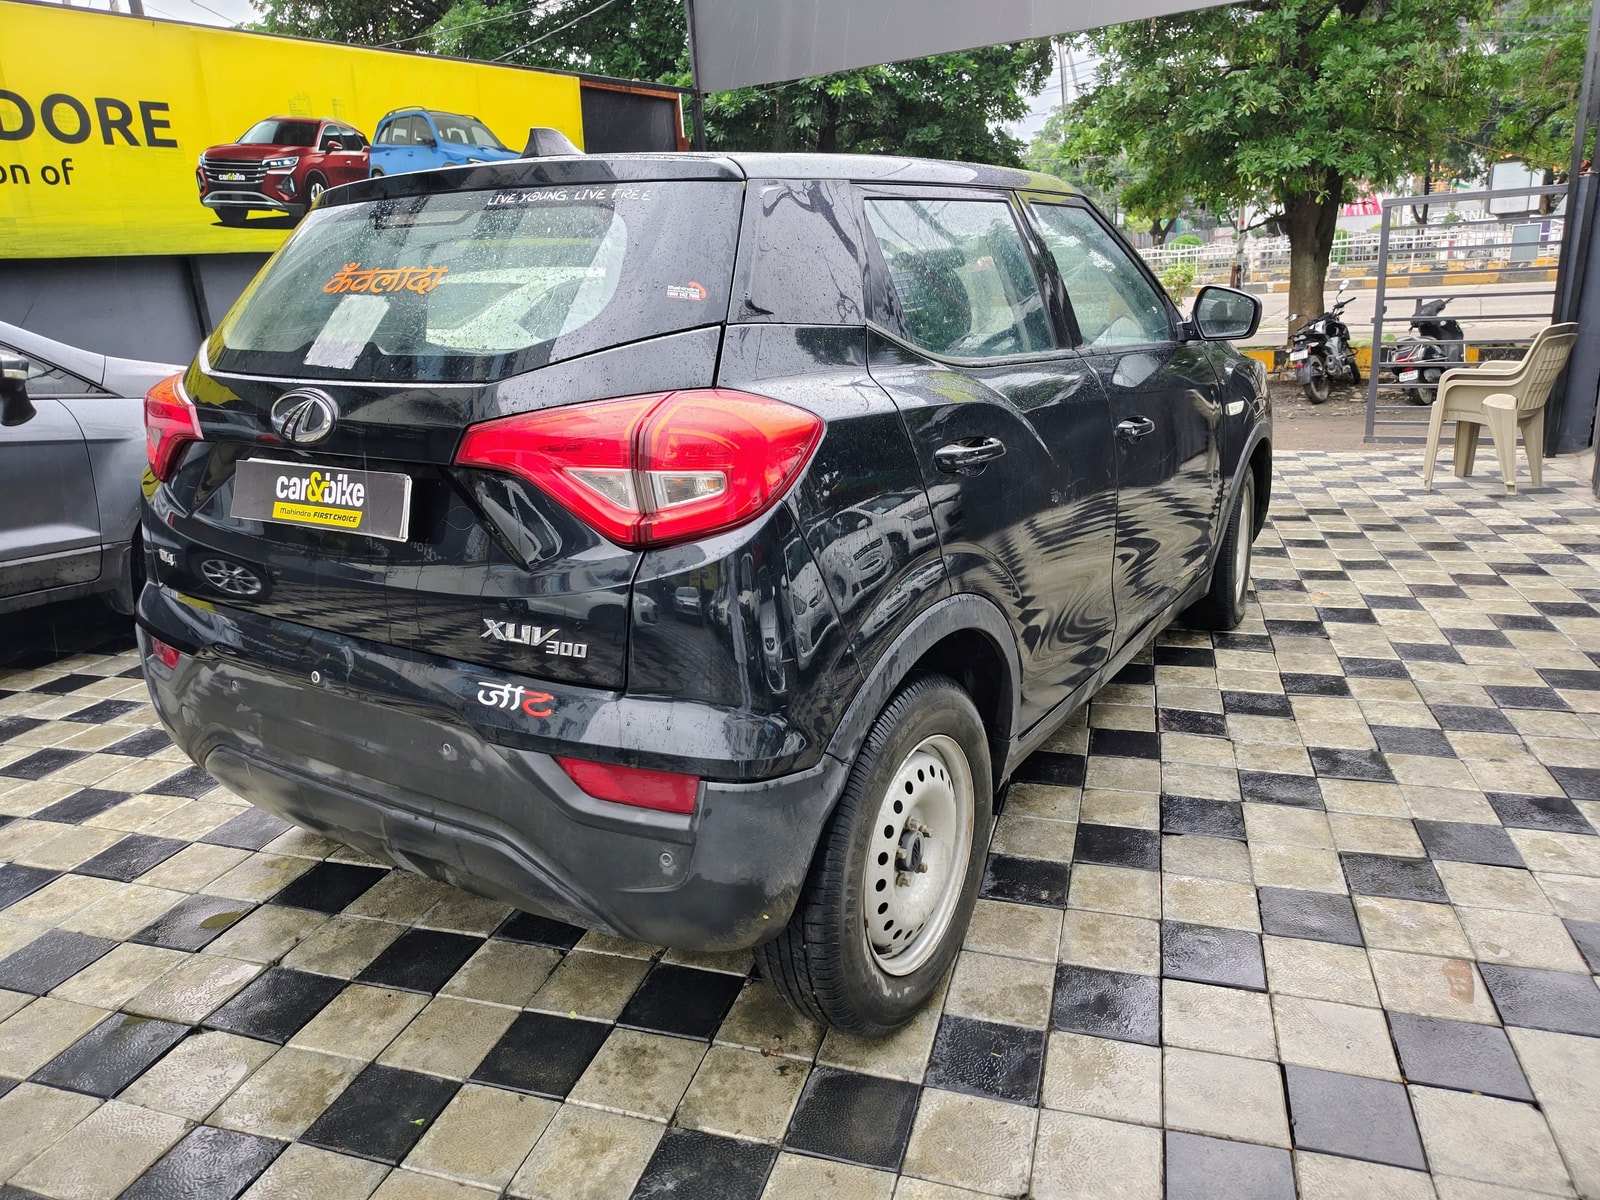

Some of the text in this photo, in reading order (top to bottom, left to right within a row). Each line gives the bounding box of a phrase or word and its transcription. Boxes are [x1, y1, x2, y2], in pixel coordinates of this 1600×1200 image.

[0, 89, 178, 148] DORE
[40, 158, 74, 186] of
[487, 193, 516, 206] LIVE
[574, 189, 607, 201] LIVE
[611, 188, 652, 201] FREE
[275, 471, 365, 507] car&bike
[279, 507, 358, 523] Mahindra FIRST CHOICE
